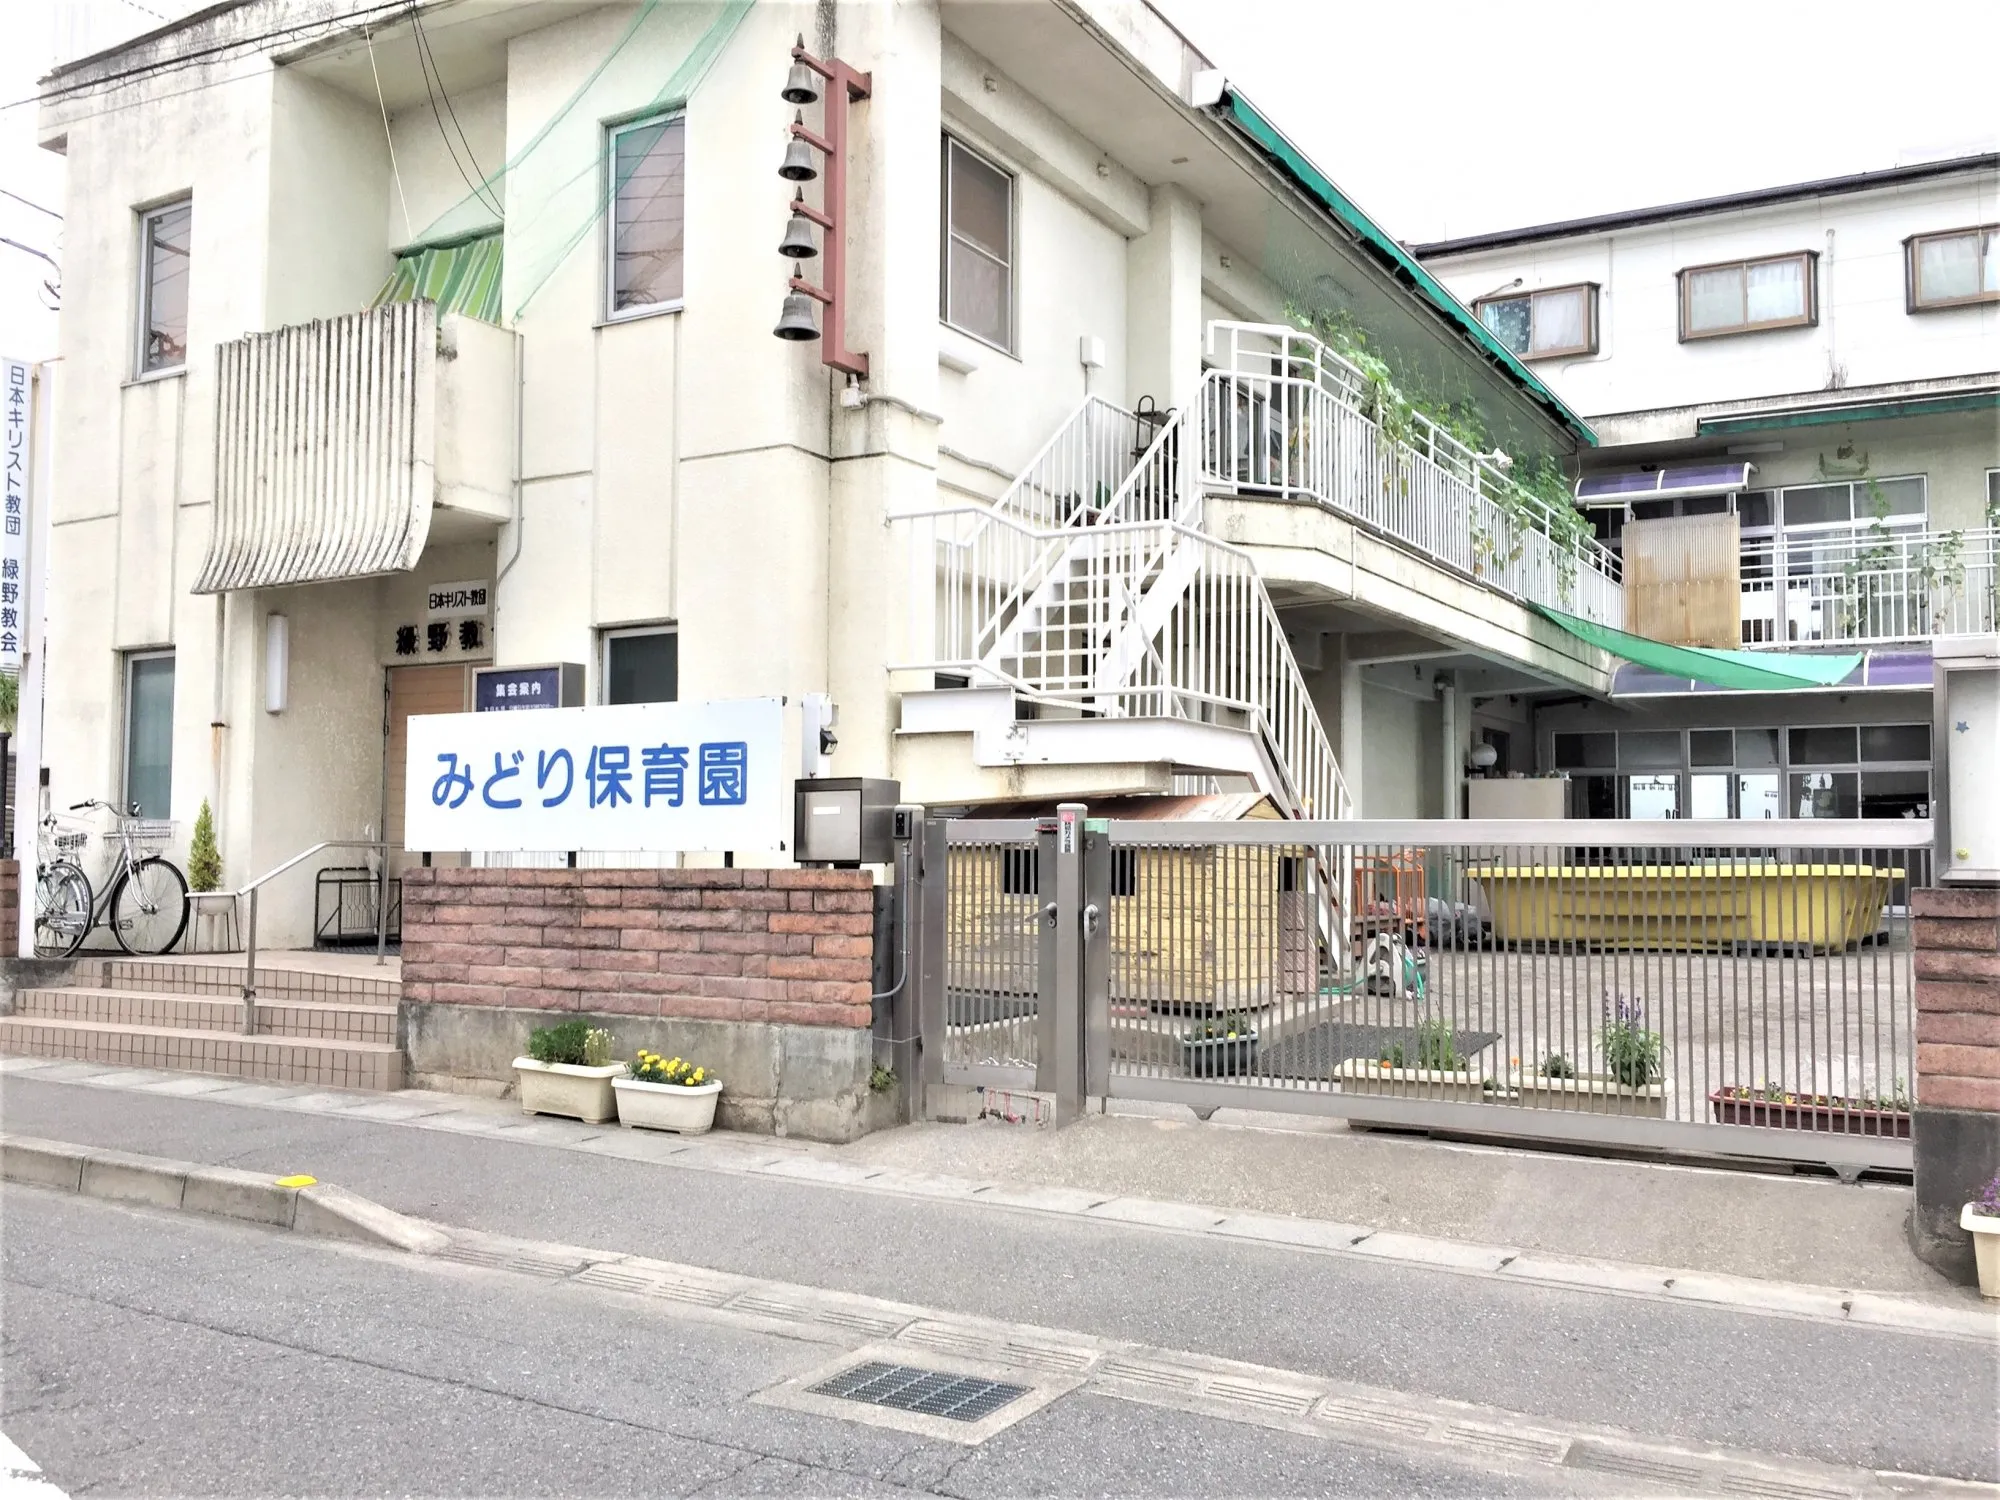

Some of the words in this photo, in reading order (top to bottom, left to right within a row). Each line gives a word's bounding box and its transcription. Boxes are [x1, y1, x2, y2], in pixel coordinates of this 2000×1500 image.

[5, 365, 25, 536] 日本キリスト教団
[1, 557, 19, 653] 緑野教会
[428, 588, 487, 610] 日本キリスト教団
[396, 620, 494, 655] 緑野教
[495, 681, 541, 698] 集会案内
[432, 741, 748, 809] みどり保育園
